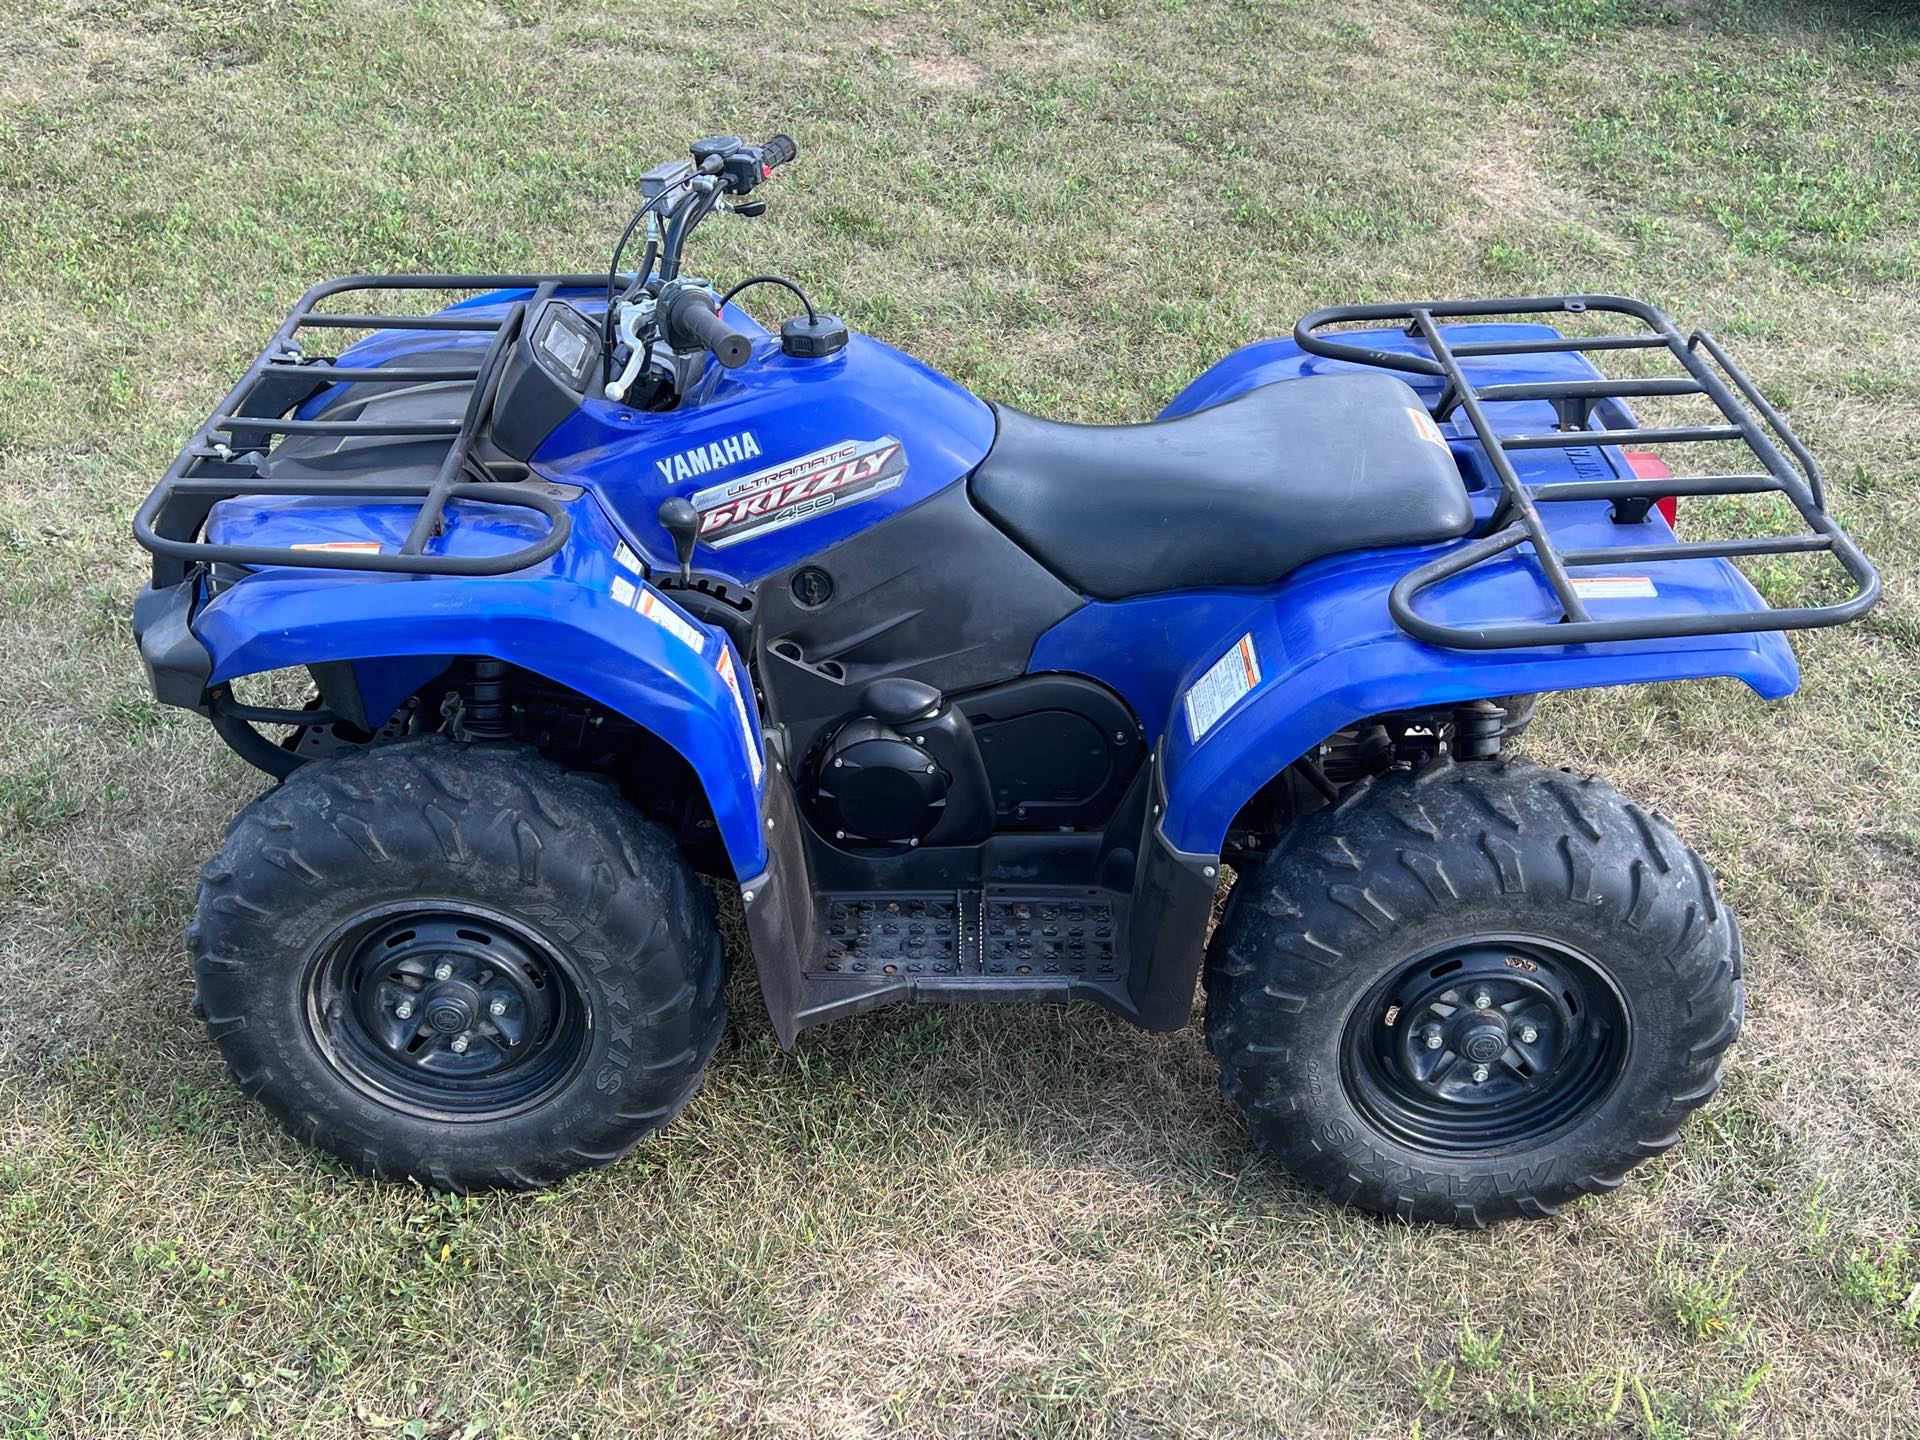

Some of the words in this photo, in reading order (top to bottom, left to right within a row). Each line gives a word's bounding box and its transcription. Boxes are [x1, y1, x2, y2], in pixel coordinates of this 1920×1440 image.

[656, 431, 761, 484] YAMAHA
[700, 442, 901, 534] GRIZZLY
[726, 445, 857, 496] ULTRAMATIC
[775, 495, 835, 521] 450
[511, 902, 633, 1096] MAXXIS
[1320, 1118, 1557, 1196] MAXXIS
